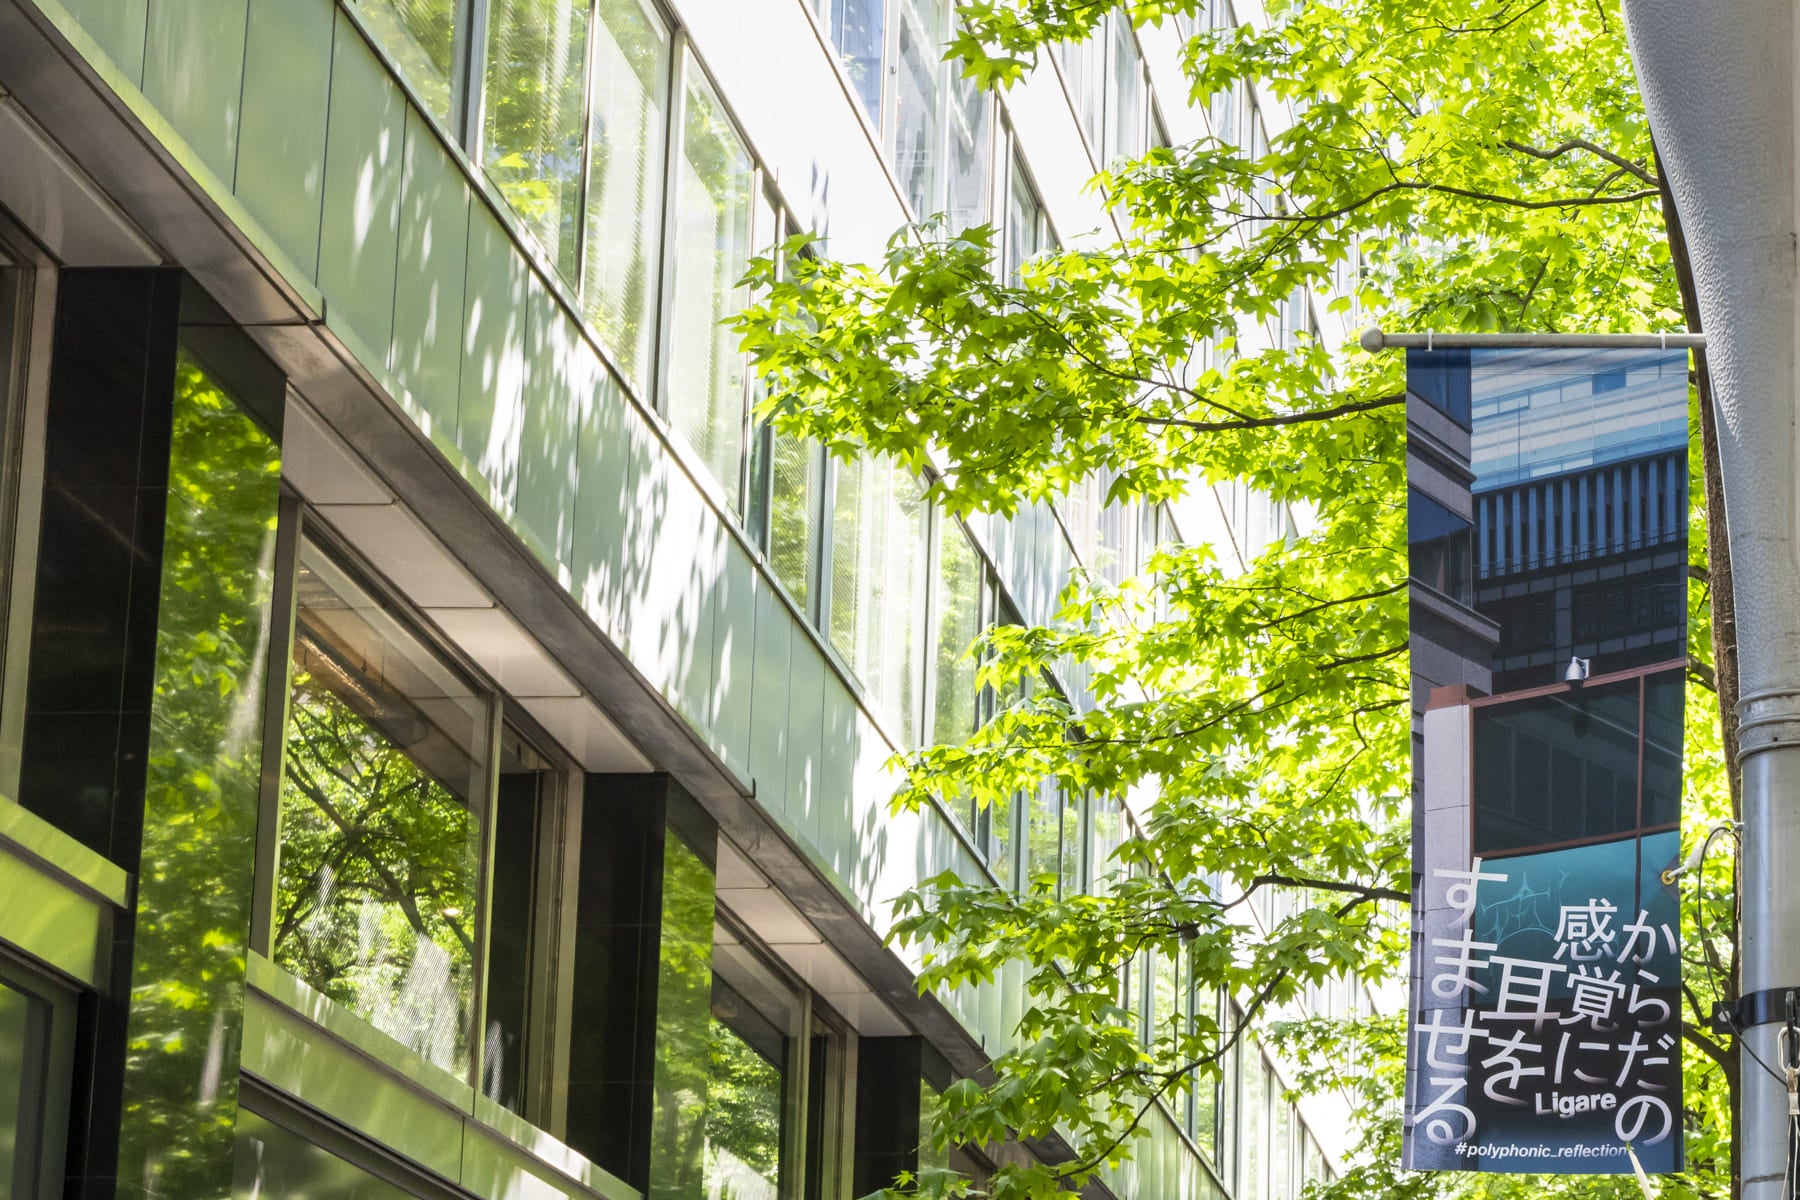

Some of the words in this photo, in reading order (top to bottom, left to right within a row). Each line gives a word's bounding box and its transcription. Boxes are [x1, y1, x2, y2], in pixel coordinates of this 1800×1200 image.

[1413, 857, 1508, 1144] すませる
[1479, 955, 1568, 1106] 耳を
[1553, 897, 1626, 1085] 感覚に
[1614, 909, 1678, 1146] からだの
[1535, 1091, 1617, 1119] Ligare
